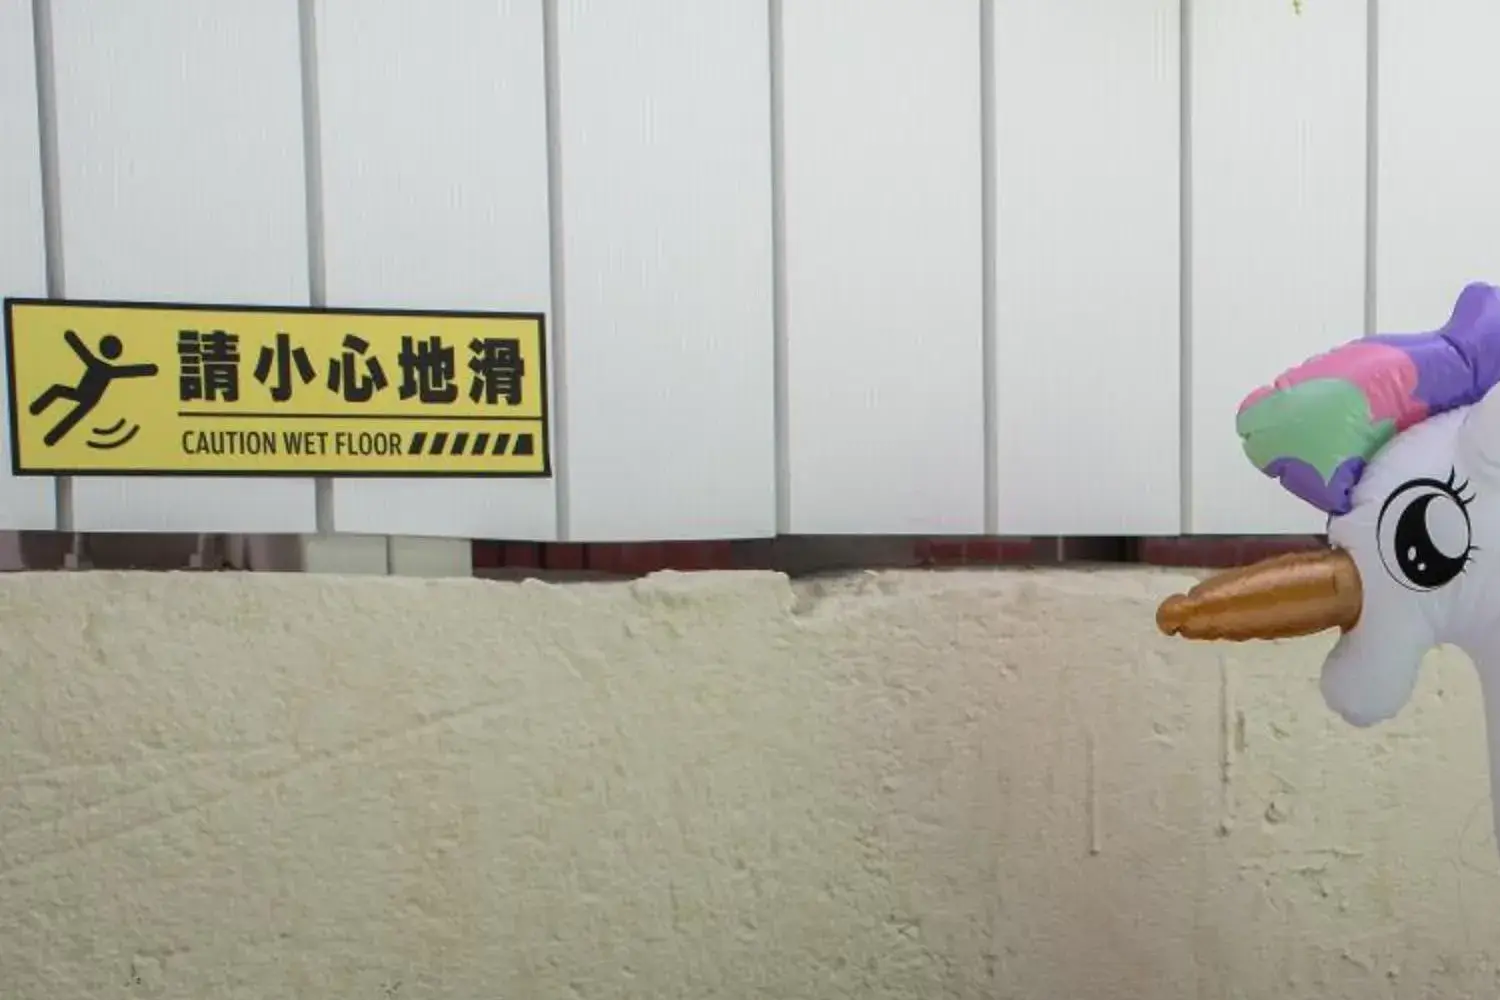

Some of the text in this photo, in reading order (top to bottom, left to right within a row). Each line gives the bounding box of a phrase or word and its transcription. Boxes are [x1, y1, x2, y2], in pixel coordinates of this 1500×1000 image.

[178, 329, 525, 405] 請小心地滑
[182, 430, 402, 457] CAUTION WET FLOOR
